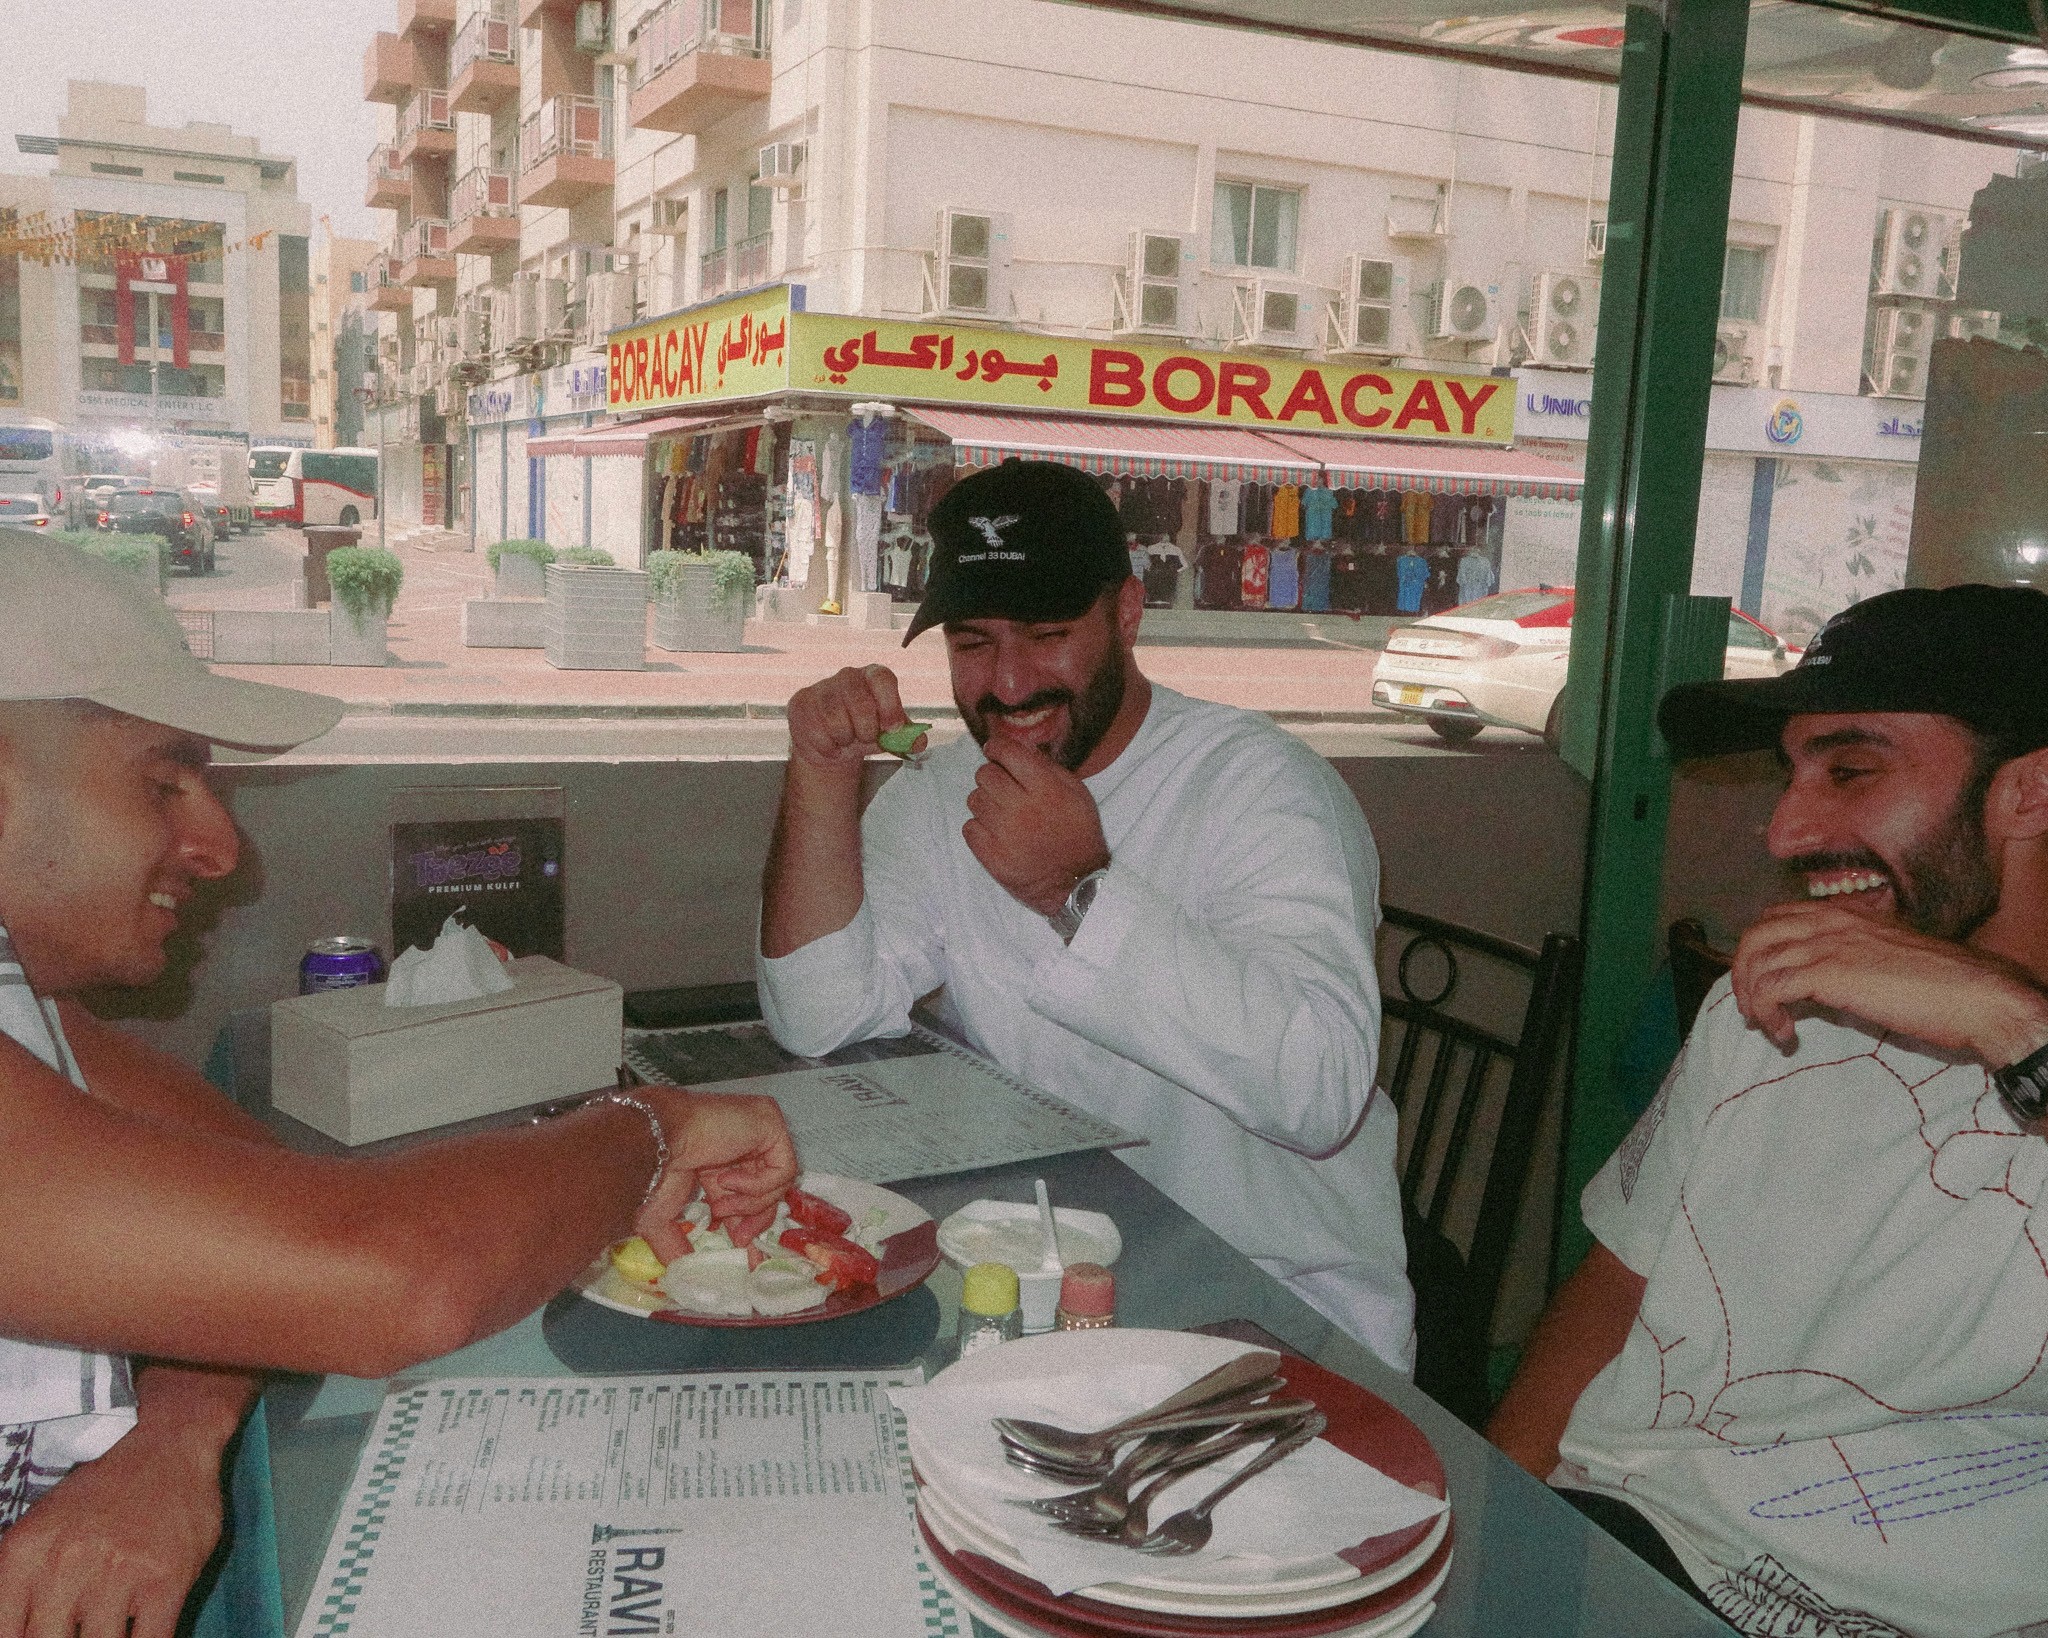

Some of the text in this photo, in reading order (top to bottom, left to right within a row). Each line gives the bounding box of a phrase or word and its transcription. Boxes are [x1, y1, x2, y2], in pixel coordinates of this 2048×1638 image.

[610, 322, 709, 404] BORACAY
[823, 330, 1059, 392] بوراكاي
[1088, 349, 1499, 435] BORACAY
[1527, 393, 1592, 417] UNIO
[958, 551, 1025, 563] Channel 33 DUBAI
[428, 882, 520, 893] PREMIUM KULFI
[579, 1549, 607, 1638] RESTAURANT
[607, 1547, 666, 1636] RAVI
